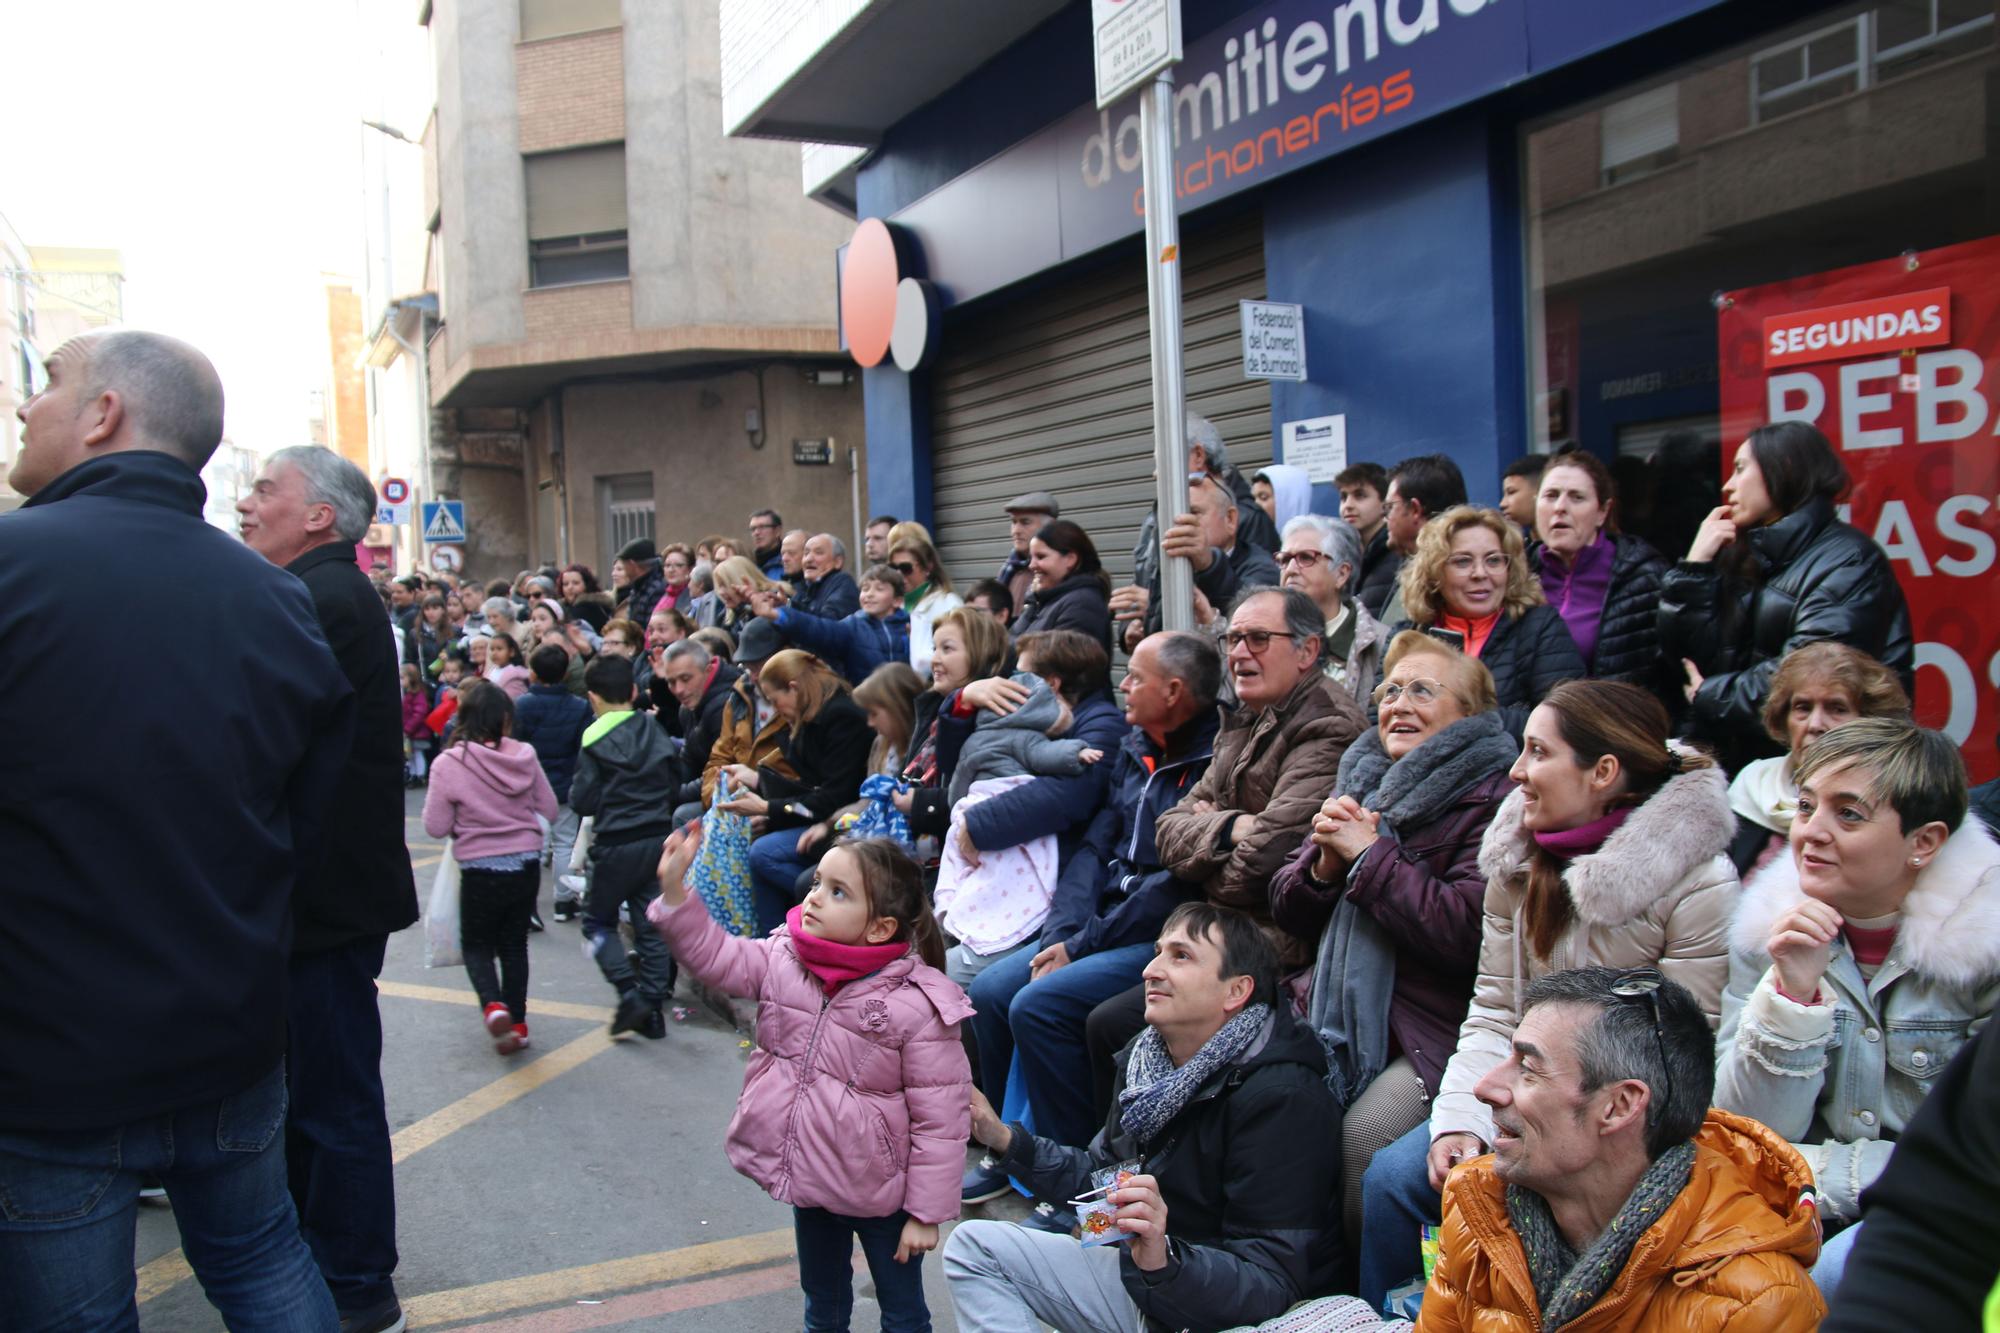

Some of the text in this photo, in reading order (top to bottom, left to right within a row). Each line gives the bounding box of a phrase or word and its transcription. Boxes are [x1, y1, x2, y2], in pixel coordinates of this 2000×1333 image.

[1133, 68, 1415, 216] clchonerías
[1252, 306, 1294, 329] Federació
[1769, 304, 1943, 356] SEGUNDAS
[1247, 352, 1259, 372] de
[1248, 330, 1297, 356] del Comerç
[1766, 348, 2000, 451] REB
